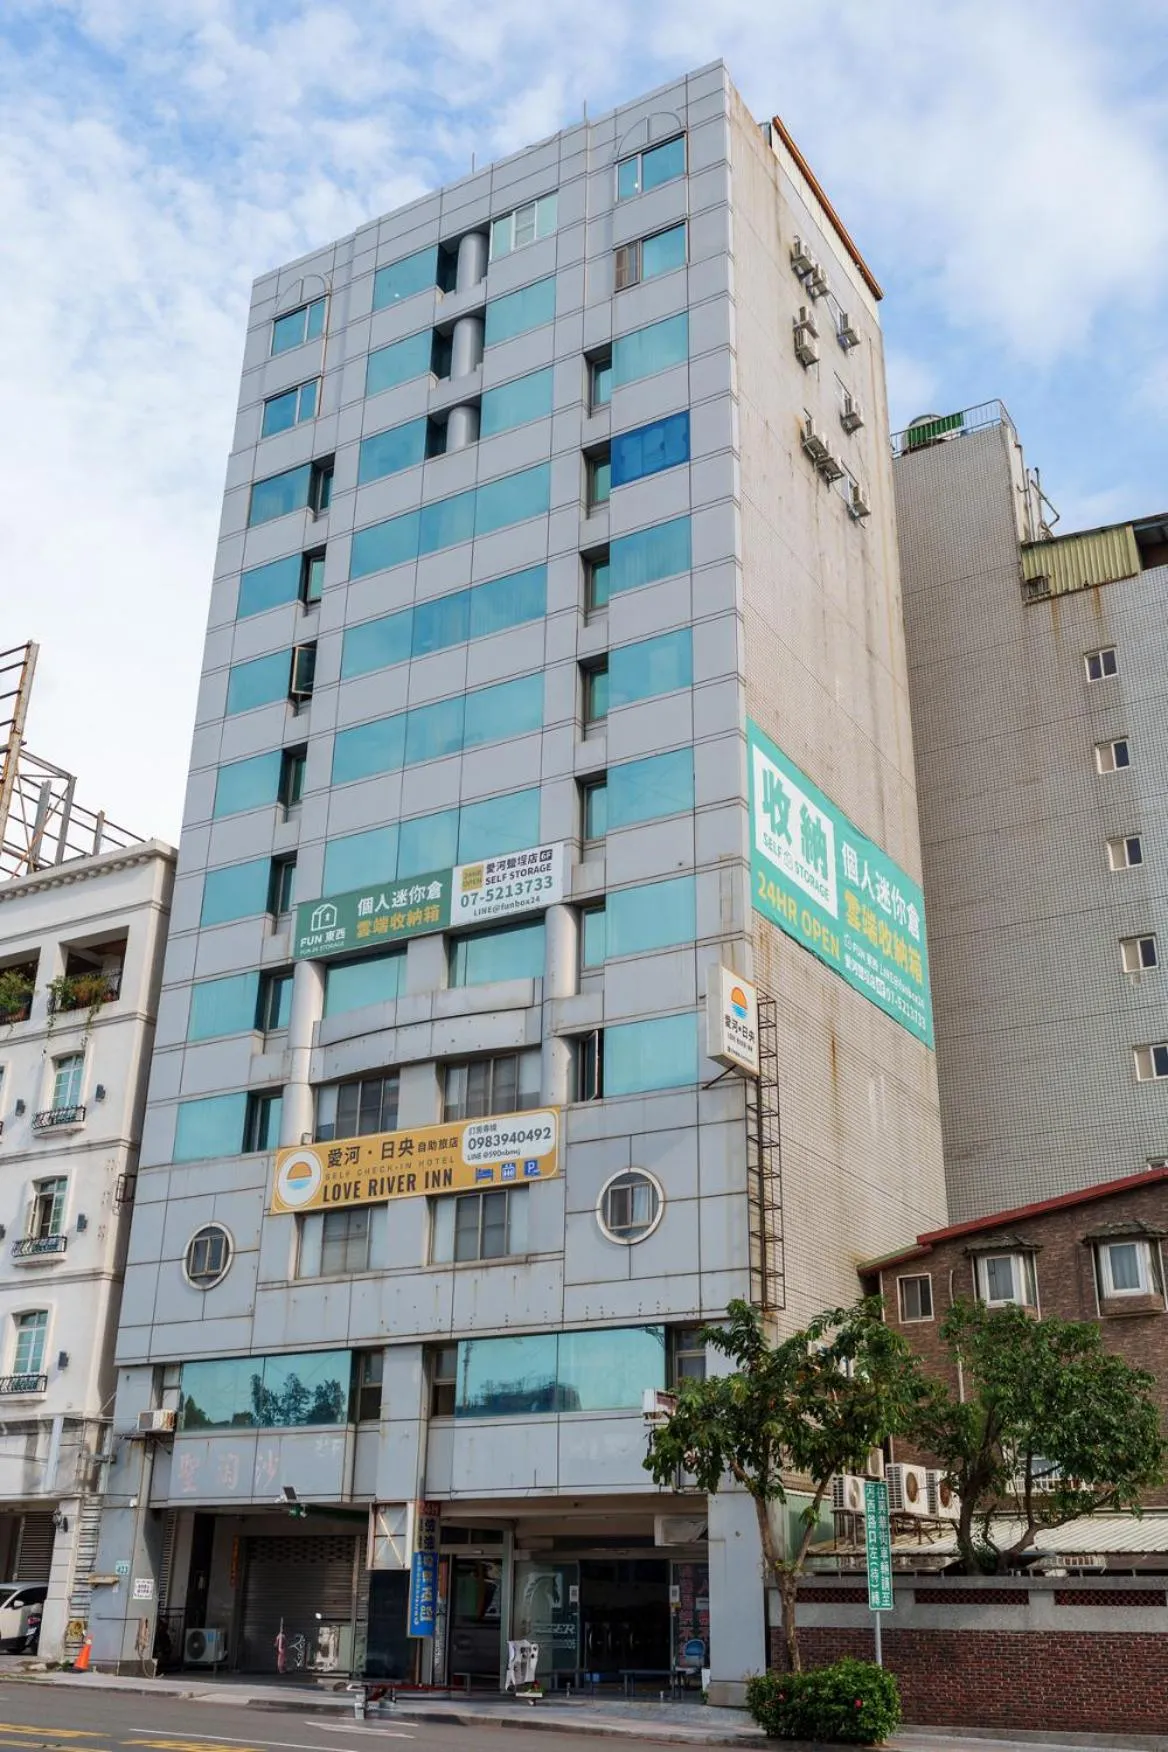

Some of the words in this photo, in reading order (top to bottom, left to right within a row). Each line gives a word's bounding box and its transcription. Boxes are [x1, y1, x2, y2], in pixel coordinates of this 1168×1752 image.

[762, 767, 829, 881] 收納
[485, 873, 508, 886] SELF
[509, 863, 552, 880] STORAGE
[763, 831, 784, 860] SELF
[793, 860, 831, 902] STORAGE
[357, 881, 443, 917] 個人迷你倉
[461, 876, 553, 908] 07-5213733
[840, 840, 921, 942] 個人迷你倉
[757, 871, 799, 927] 24HR
[801, 909, 840, 962] OPEN
[300, 934, 322, 947] FUN
[324, 928, 346, 942] 東西
[417, 1136, 459, 1153] 自助旅店
[468, 1127, 551, 1150] 0983940492
[325, 1170, 349, 1181] SELF
[356, 1161, 413, 1178] CHECK-IN
[419, 1155, 455, 1168] HOTEL
[323, 1179, 361, 1203] LOVE
[368, 1172, 416, 1197] RIVER
[425, 1168, 453, 1189] INN
